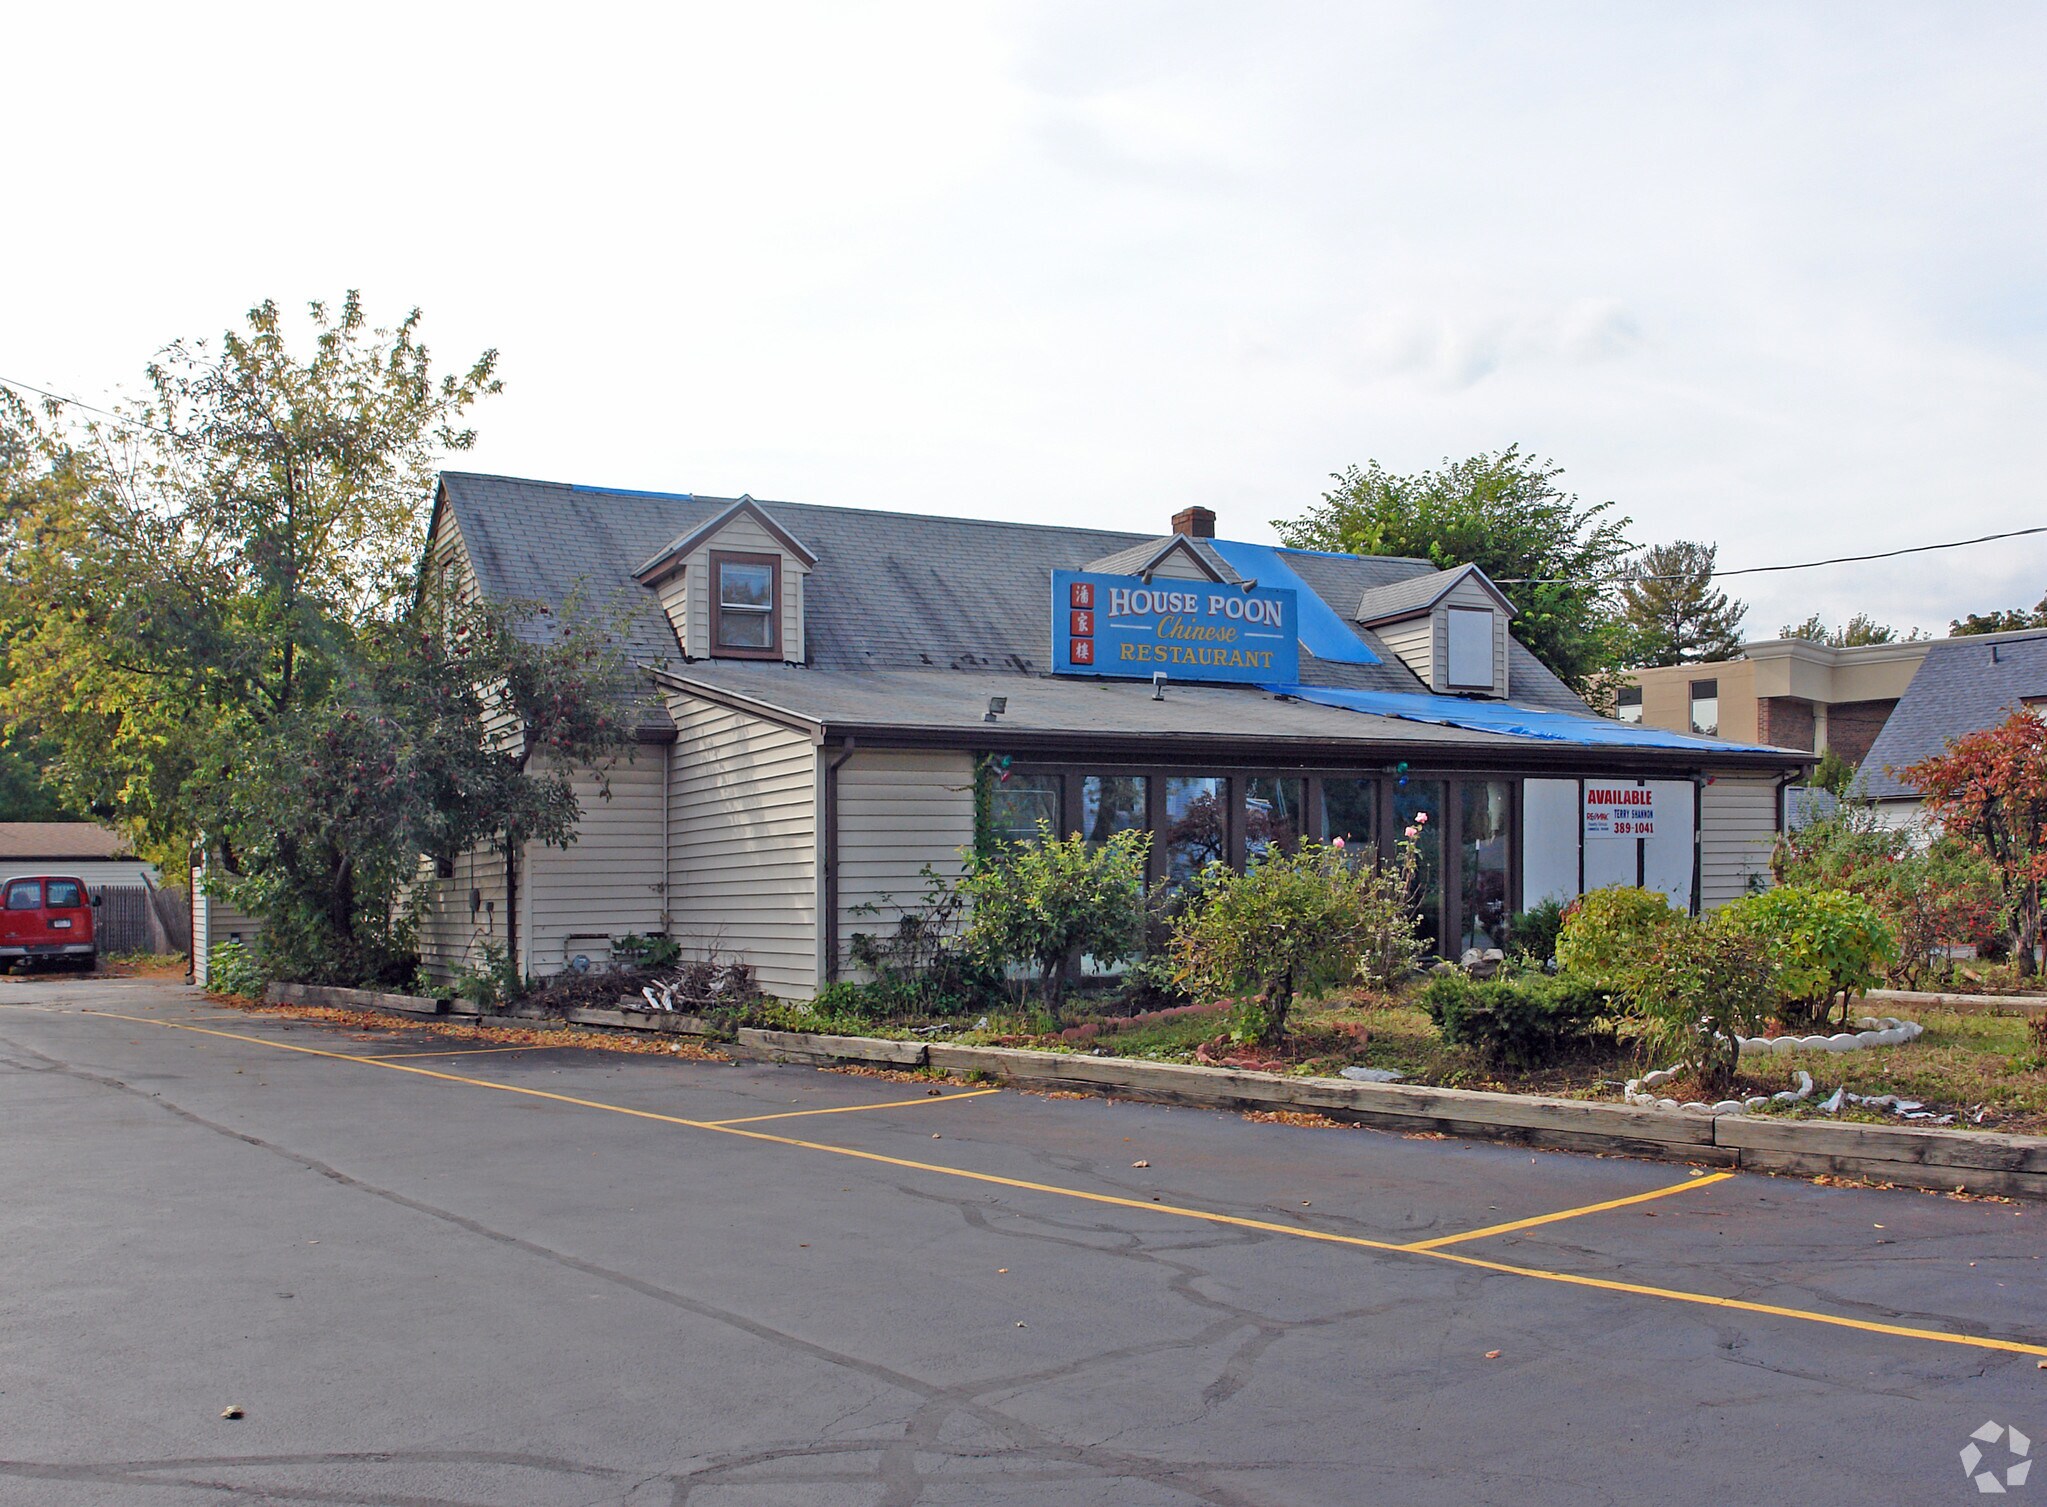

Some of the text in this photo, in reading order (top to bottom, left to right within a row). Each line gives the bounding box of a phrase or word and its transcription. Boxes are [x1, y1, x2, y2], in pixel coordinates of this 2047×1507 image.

[1109, 588, 1283, 627] HOUSE POON
[1156, 615, 1239, 642] Chinese
[1120, 643, 1274, 668] RESTAURANT
[1587, 790, 1652, 805] AVAILABLE
[1614, 809, 1654, 819] TERRY SHANNON
[1614, 822, 1654, 834] 389-1041
